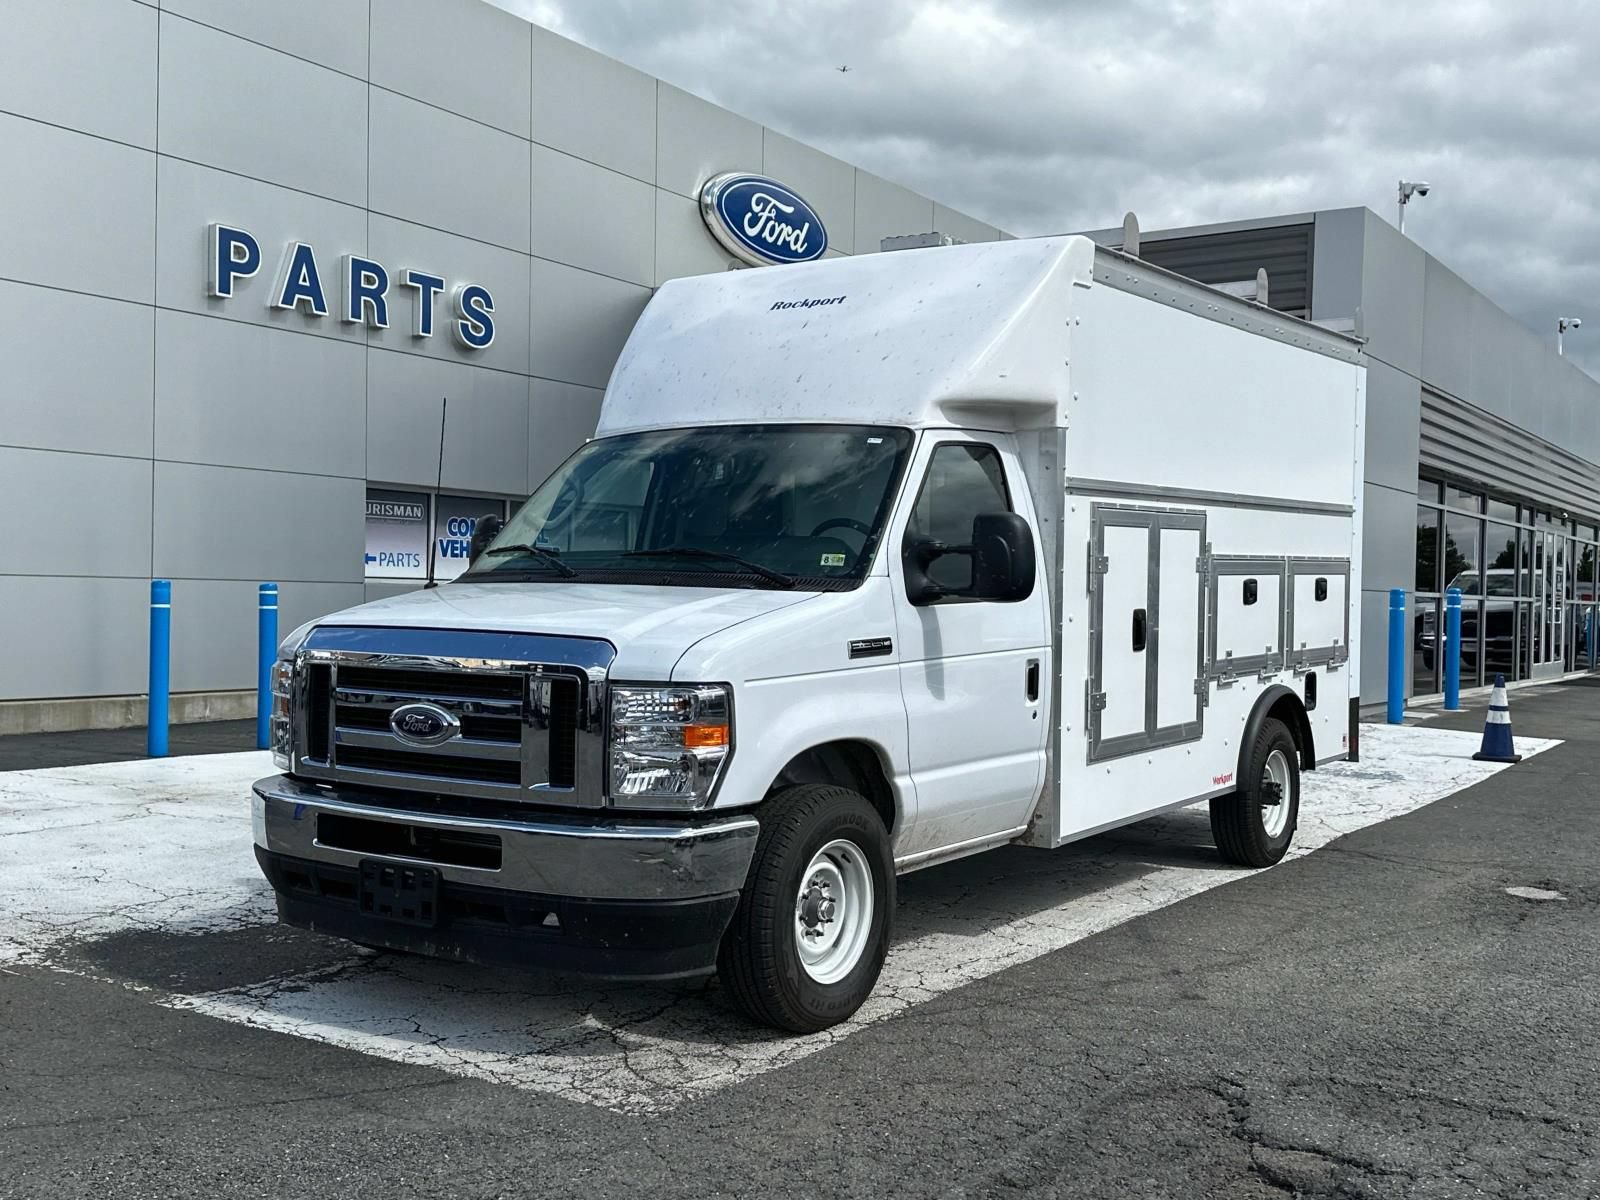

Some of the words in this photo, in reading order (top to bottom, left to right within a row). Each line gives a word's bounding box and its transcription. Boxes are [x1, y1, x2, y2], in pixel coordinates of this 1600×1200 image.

[744, 193, 809, 253] Ford
[208, 223, 495, 348] PARTS
[770, 296, 847, 311] Rockport
[379, 552, 421, 567] PARTS
[402, 714, 432, 732] Ford
